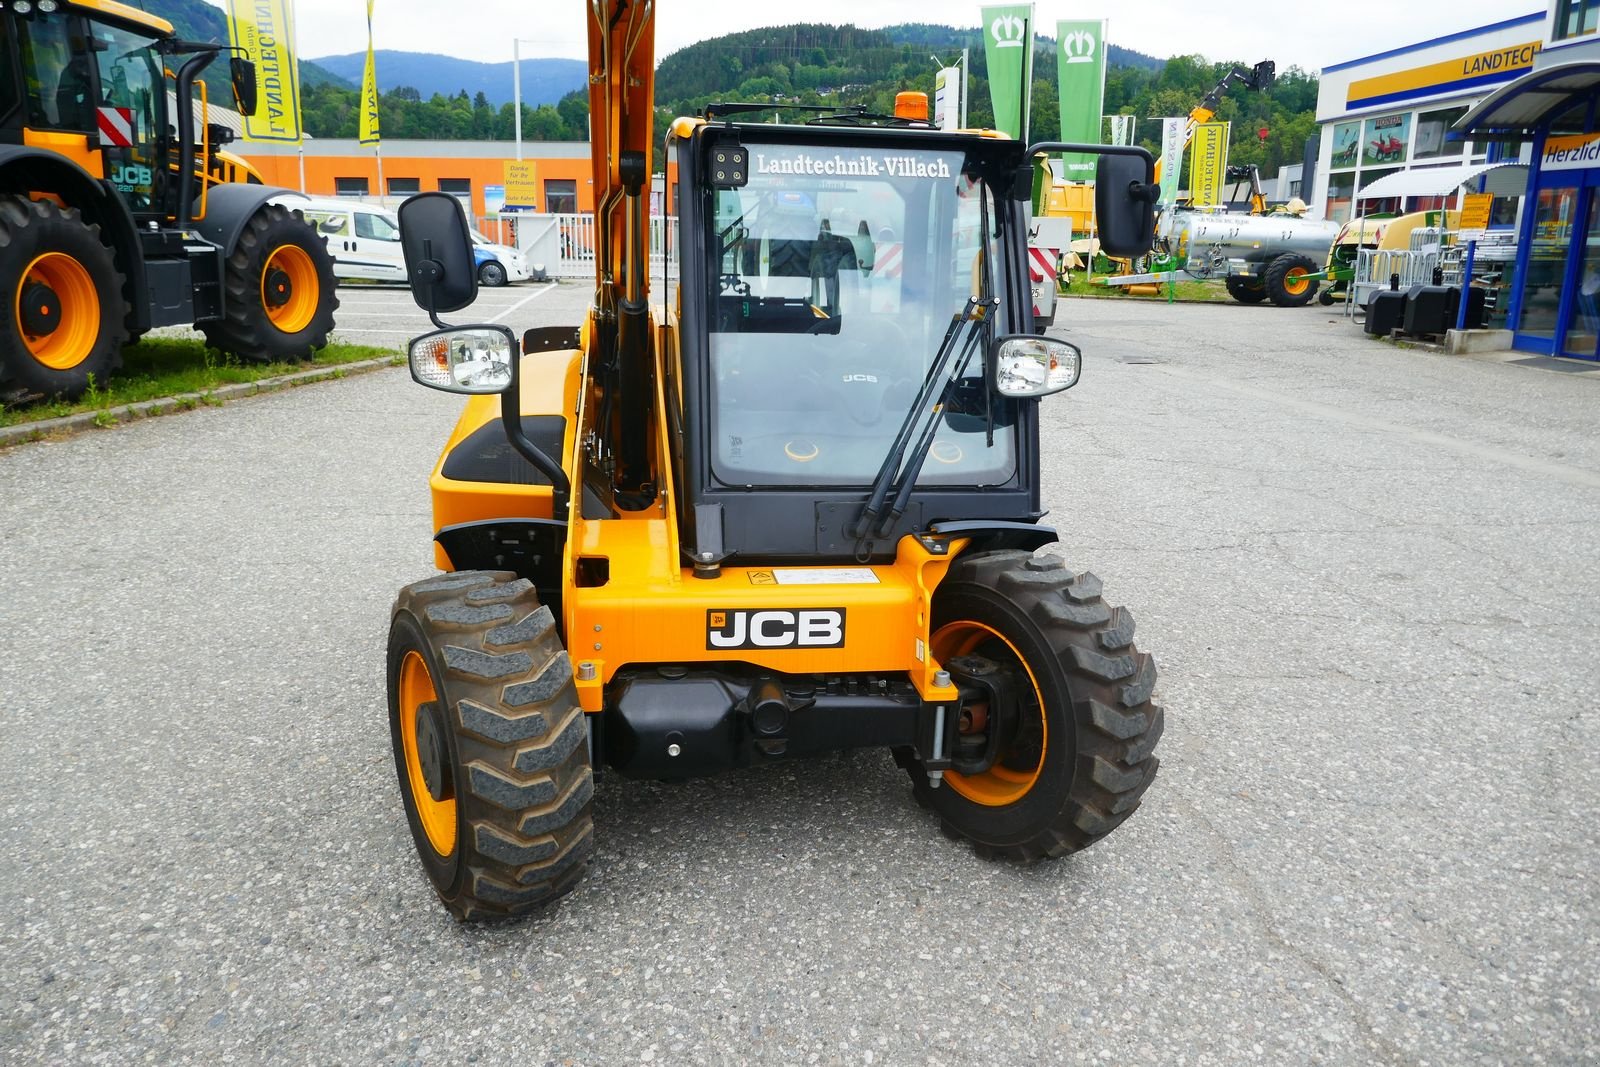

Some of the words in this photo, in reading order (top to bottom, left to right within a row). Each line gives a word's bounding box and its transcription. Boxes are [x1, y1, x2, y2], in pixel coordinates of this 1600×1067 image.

[111, 166, 152, 184] JCB
[757, 154, 950, 178] Landtechnik-Villach
[842, 374, 878, 383] JCB
[709, 610, 842, 647] JCB
